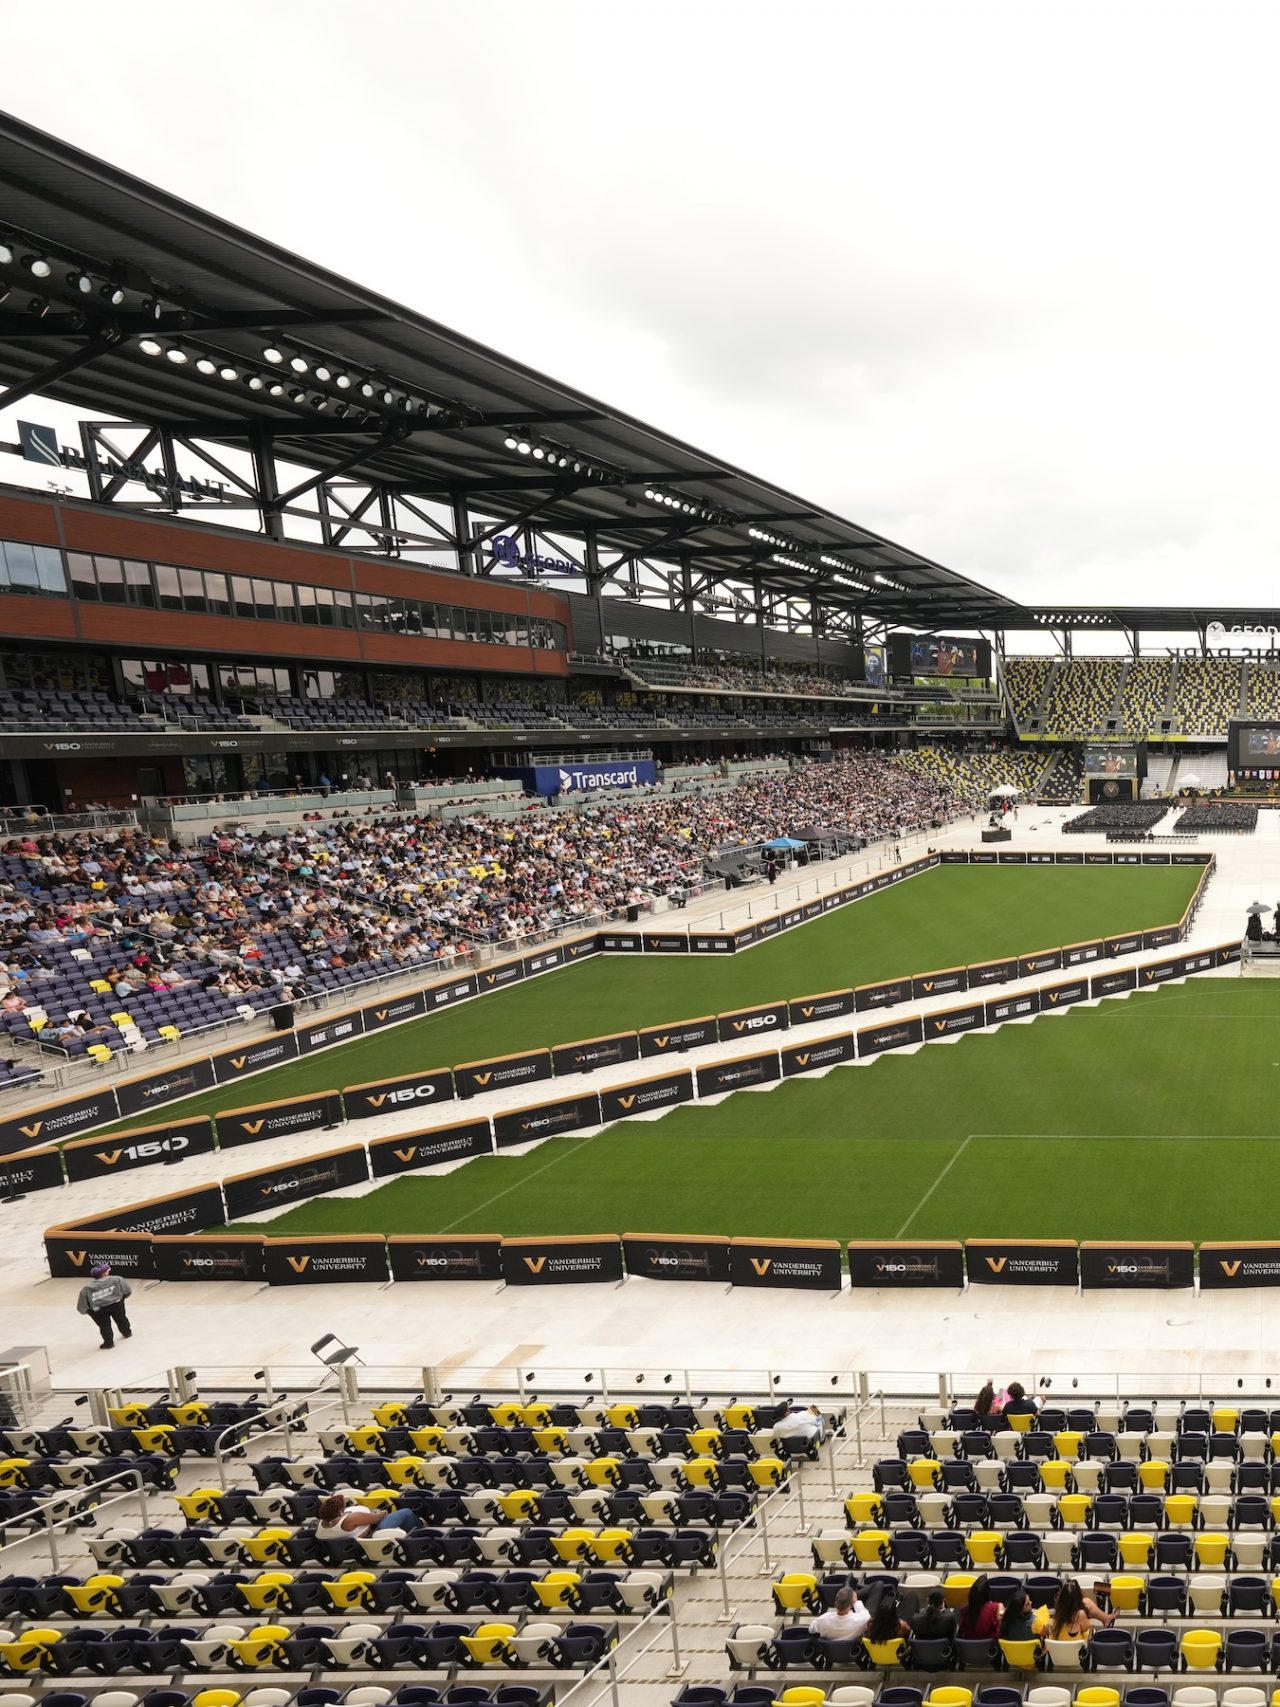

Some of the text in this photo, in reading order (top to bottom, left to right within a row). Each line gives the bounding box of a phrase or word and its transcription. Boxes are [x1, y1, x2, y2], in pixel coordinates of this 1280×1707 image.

[44, 742, 81, 750] V150
[572, 766, 637, 788] Transcard
[732, 1014, 777, 1031] V150
[310, 1032, 327, 1045] DARE
[335, 1022, 352, 1036] GROW
[493, 1065, 536, 1077] VANDERBILT
[494, 1068, 536, 1081] UNIVERSITY
[718, 1072, 743, 1082] V150
[143, 1083, 169, 1097] V150
[366, 1084, 435, 1107] V150
[637, 1086, 678, 1100] VANDERBILT
[637, 1089, 678, 1104] UNIVERSITY
[45, 1106, 98, 1126] VANDERBILT
[46, 1110, 99, 1131] UNIVERSITY
[267, 1109, 322, 1125] VANDERBILT
[268, 1114, 322, 1129] UNIVERSITY
[522, 1117, 552, 1130] V150
[94, 1136, 189, 1165] V150
[419, 1136, 473, 1152] VANDERBILT
[420, 1141, 473, 1157] UNIVERSITY
[261, 1179, 300, 1195] V150
[183, 1258, 214, 1266] V150
[417, 1258, 448, 1266] V150
[549, 1263, 601, 1271] UNIVERSITY
[650, 1257, 679, 1265] V150
[876, 1264, 907, 1272] V150
[1107, 1265, 1138, 1273] V150
